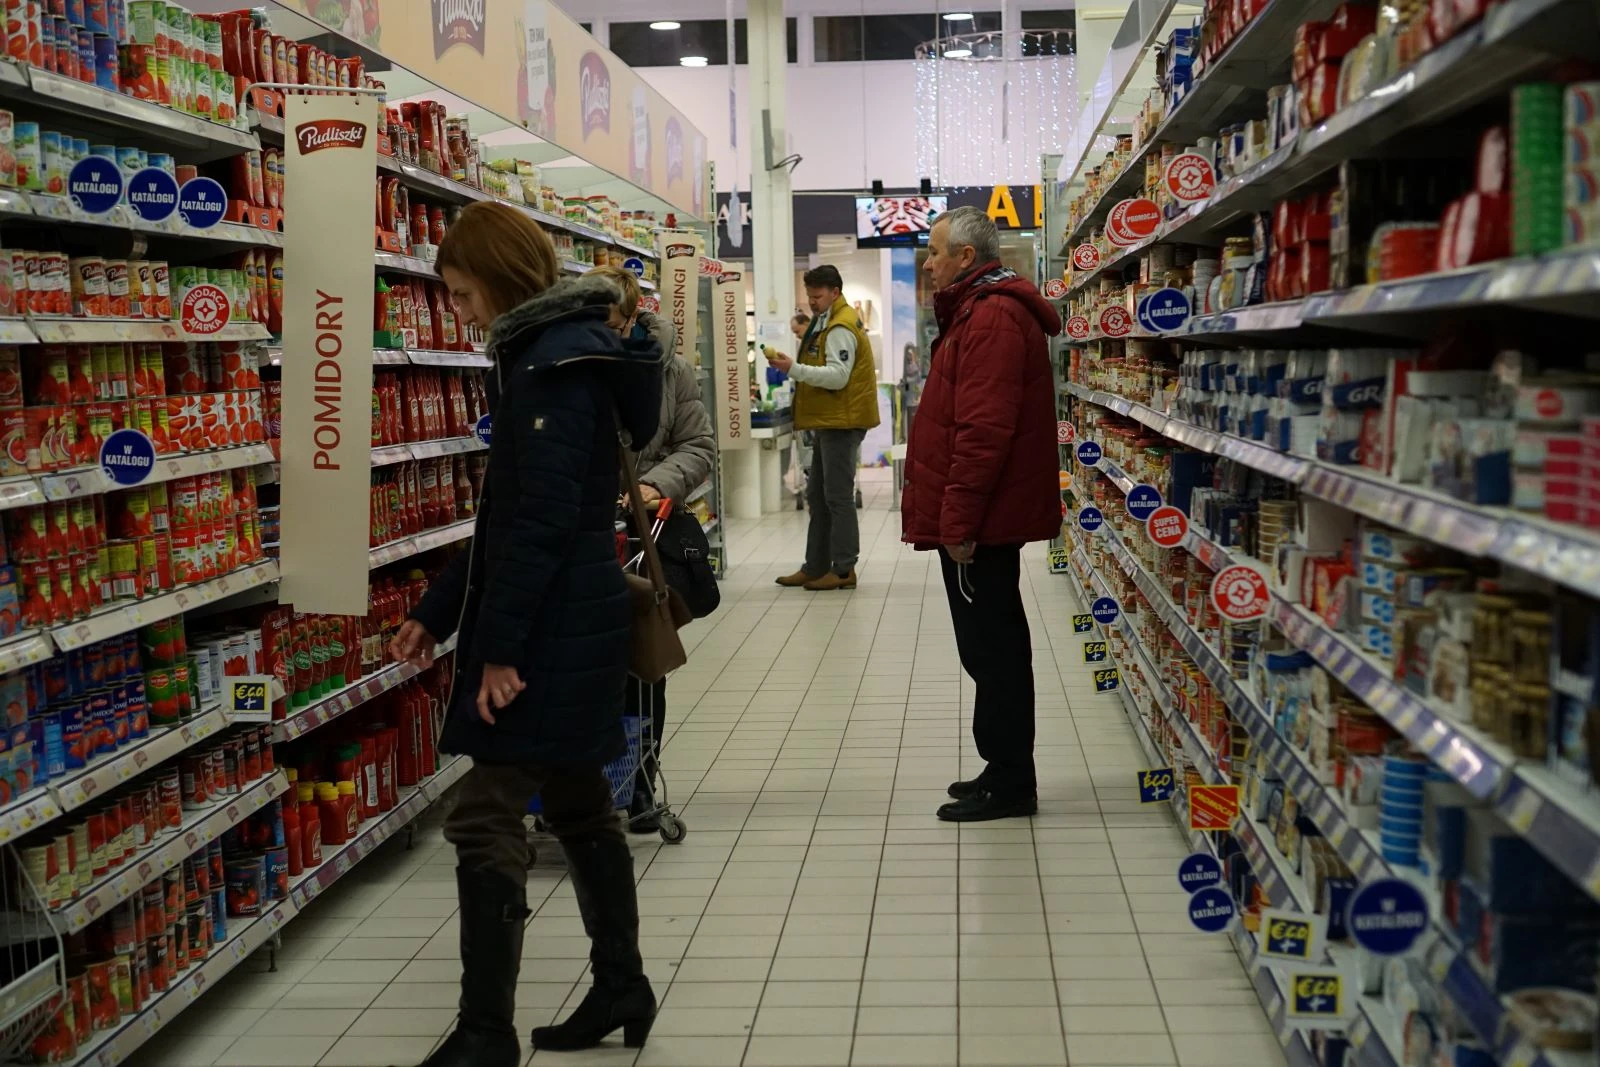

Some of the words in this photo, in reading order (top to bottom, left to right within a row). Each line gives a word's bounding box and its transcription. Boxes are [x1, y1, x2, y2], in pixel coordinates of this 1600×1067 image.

[299, 127, 362, 148] Pudliszki
[91, 172, 100, 182] W
[73, 182, 118, 195] KATALOGU
[148, 183, 157, 193] W
[132, 192, 174, 203] KATALOGU
[198, 192, 207, 201] W
[181, 200, 222, 211] KATALOGU
[1164, 300, 1173, 308] W
[1152, 306, 1187, 317] KATALOGU
[188, 317, 223, 331] MARKA
[724, 291, 737, 355] DRESSINGI
[313, 289, 343, 471] POMIDORY
[728, 366, 740, 402] ZIMNE
[729, 406, 741, 438] SOSY
[123, 445, 133, 455] W
[105, 455, 149, 467] KATALOGU
[1129, 500, 1159, 508] KATALOGU
[1154, 515, 1180, 528] SUPER
[1155, 525, 1182, 538] CENA
[1094, 608, 1117, 616] KATALOGU
[1182, 871, 1218, 882] KATALOGU
[1206, 899, 1215, 908] W
[1192, 905, 1232, 920] KATALOGU
[1355, 912, 1425, 930] KATALOGU
